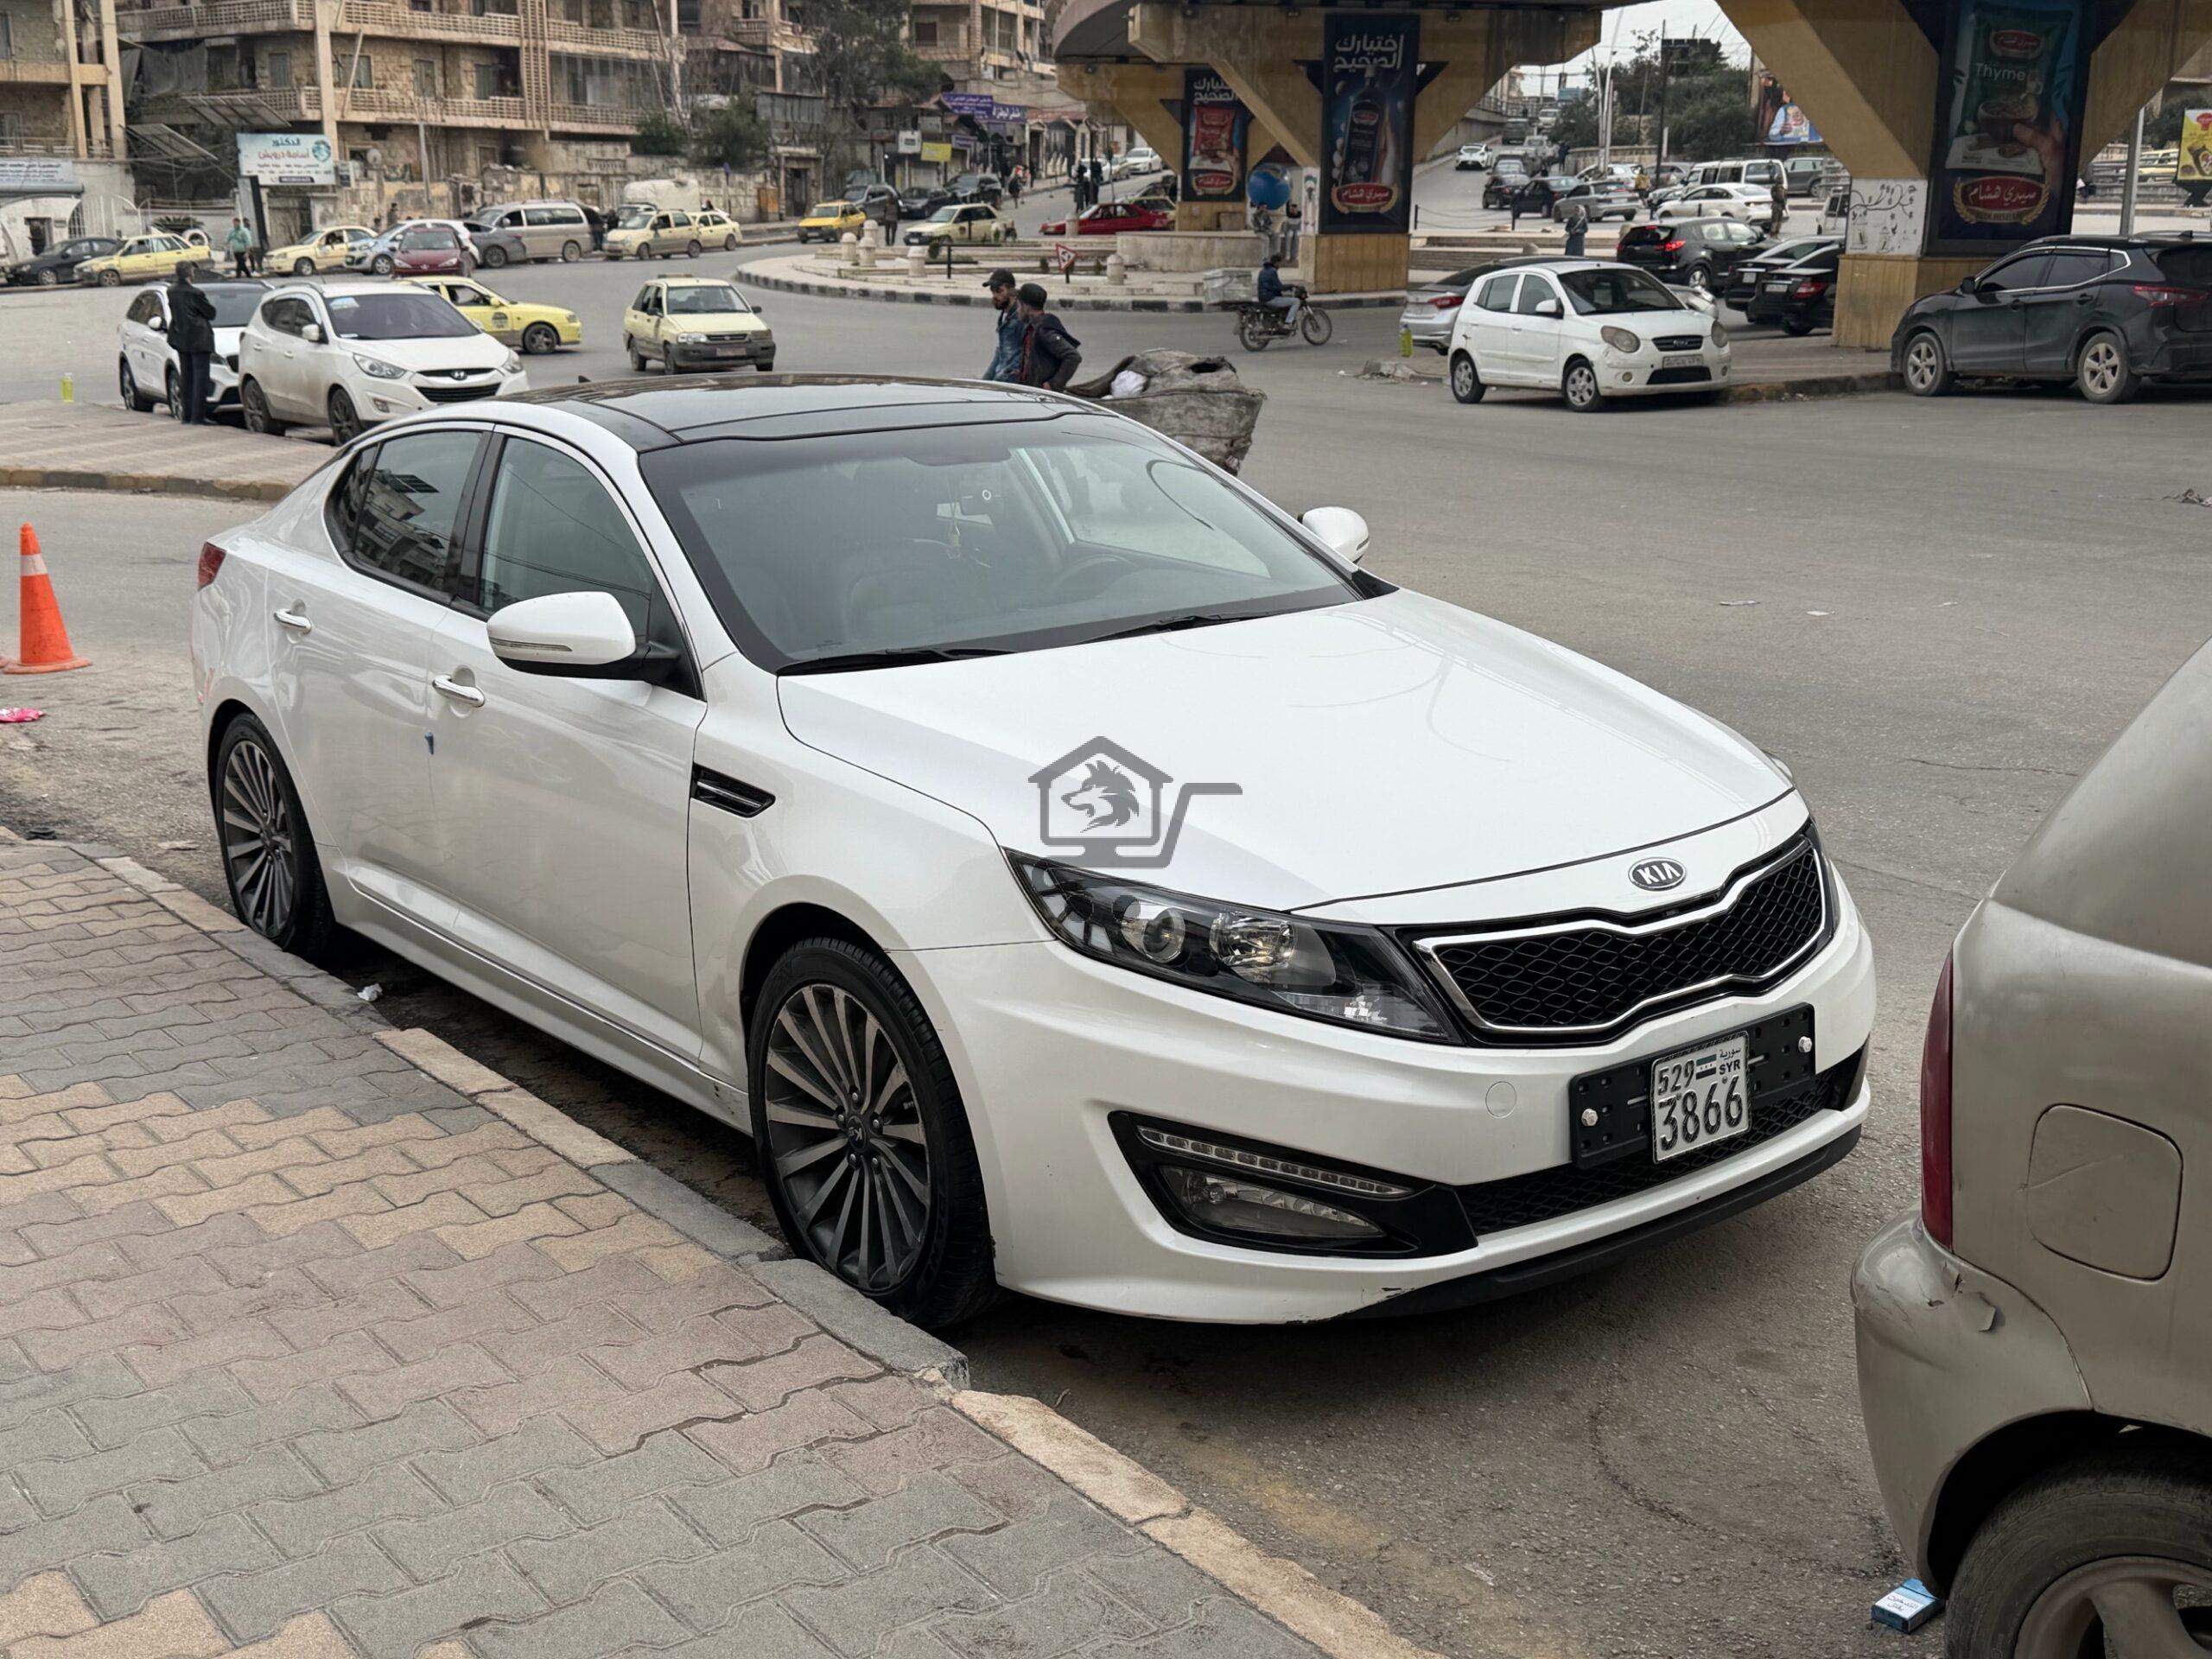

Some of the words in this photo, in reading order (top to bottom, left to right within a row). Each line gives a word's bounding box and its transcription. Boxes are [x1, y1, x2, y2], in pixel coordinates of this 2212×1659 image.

[1334, 34, 1404, 61] اختيارك
[1333, 51, 1401, 73] الصحيح
[1975, 63, 2026, 82] Thyme
[1193, 77, 1231, 92] تيارك
[1193, 88, 1236, 105] لصحيح
[272, 137, 301, 147] الدكتور
[1342, 188, 1365, 200] هشام
[1365, 188, 1389, 202] سيدي
[1968, 184, 2002, 204] هشام
[2004, 186, 2037, 207] سيدي
[1637, 862, 1681, 885] KIA
[1719, 1047, 1741, 1061] سورية
[1719, 1058, 1741, 1076] SYR
[1658, 1059, 1694, 1096] 529
[1657, 1074, 1743, 1152] 3866
